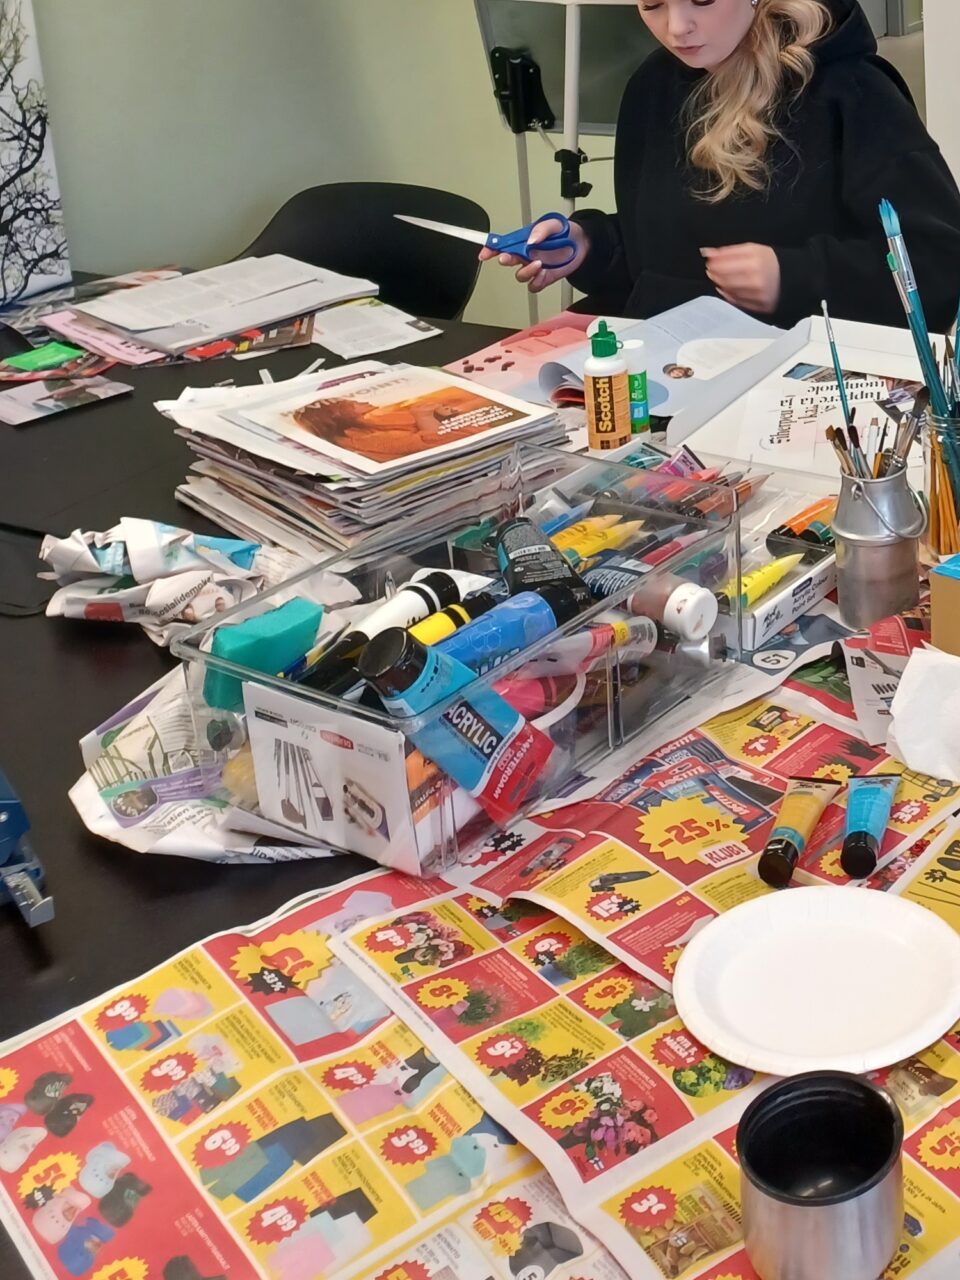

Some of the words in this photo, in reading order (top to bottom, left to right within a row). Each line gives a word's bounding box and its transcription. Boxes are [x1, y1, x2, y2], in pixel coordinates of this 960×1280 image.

[596, 377, 612, 432] Scotch
[447, 703, 498, 755] ACRYLIC
[656, 734, 698, 757] LOCTITE
[493, 735, 535, 799] AMSTERDAM
[658, 766, 705, 787] LOCTITE
[705, 844, 745, 863] KLUBI
